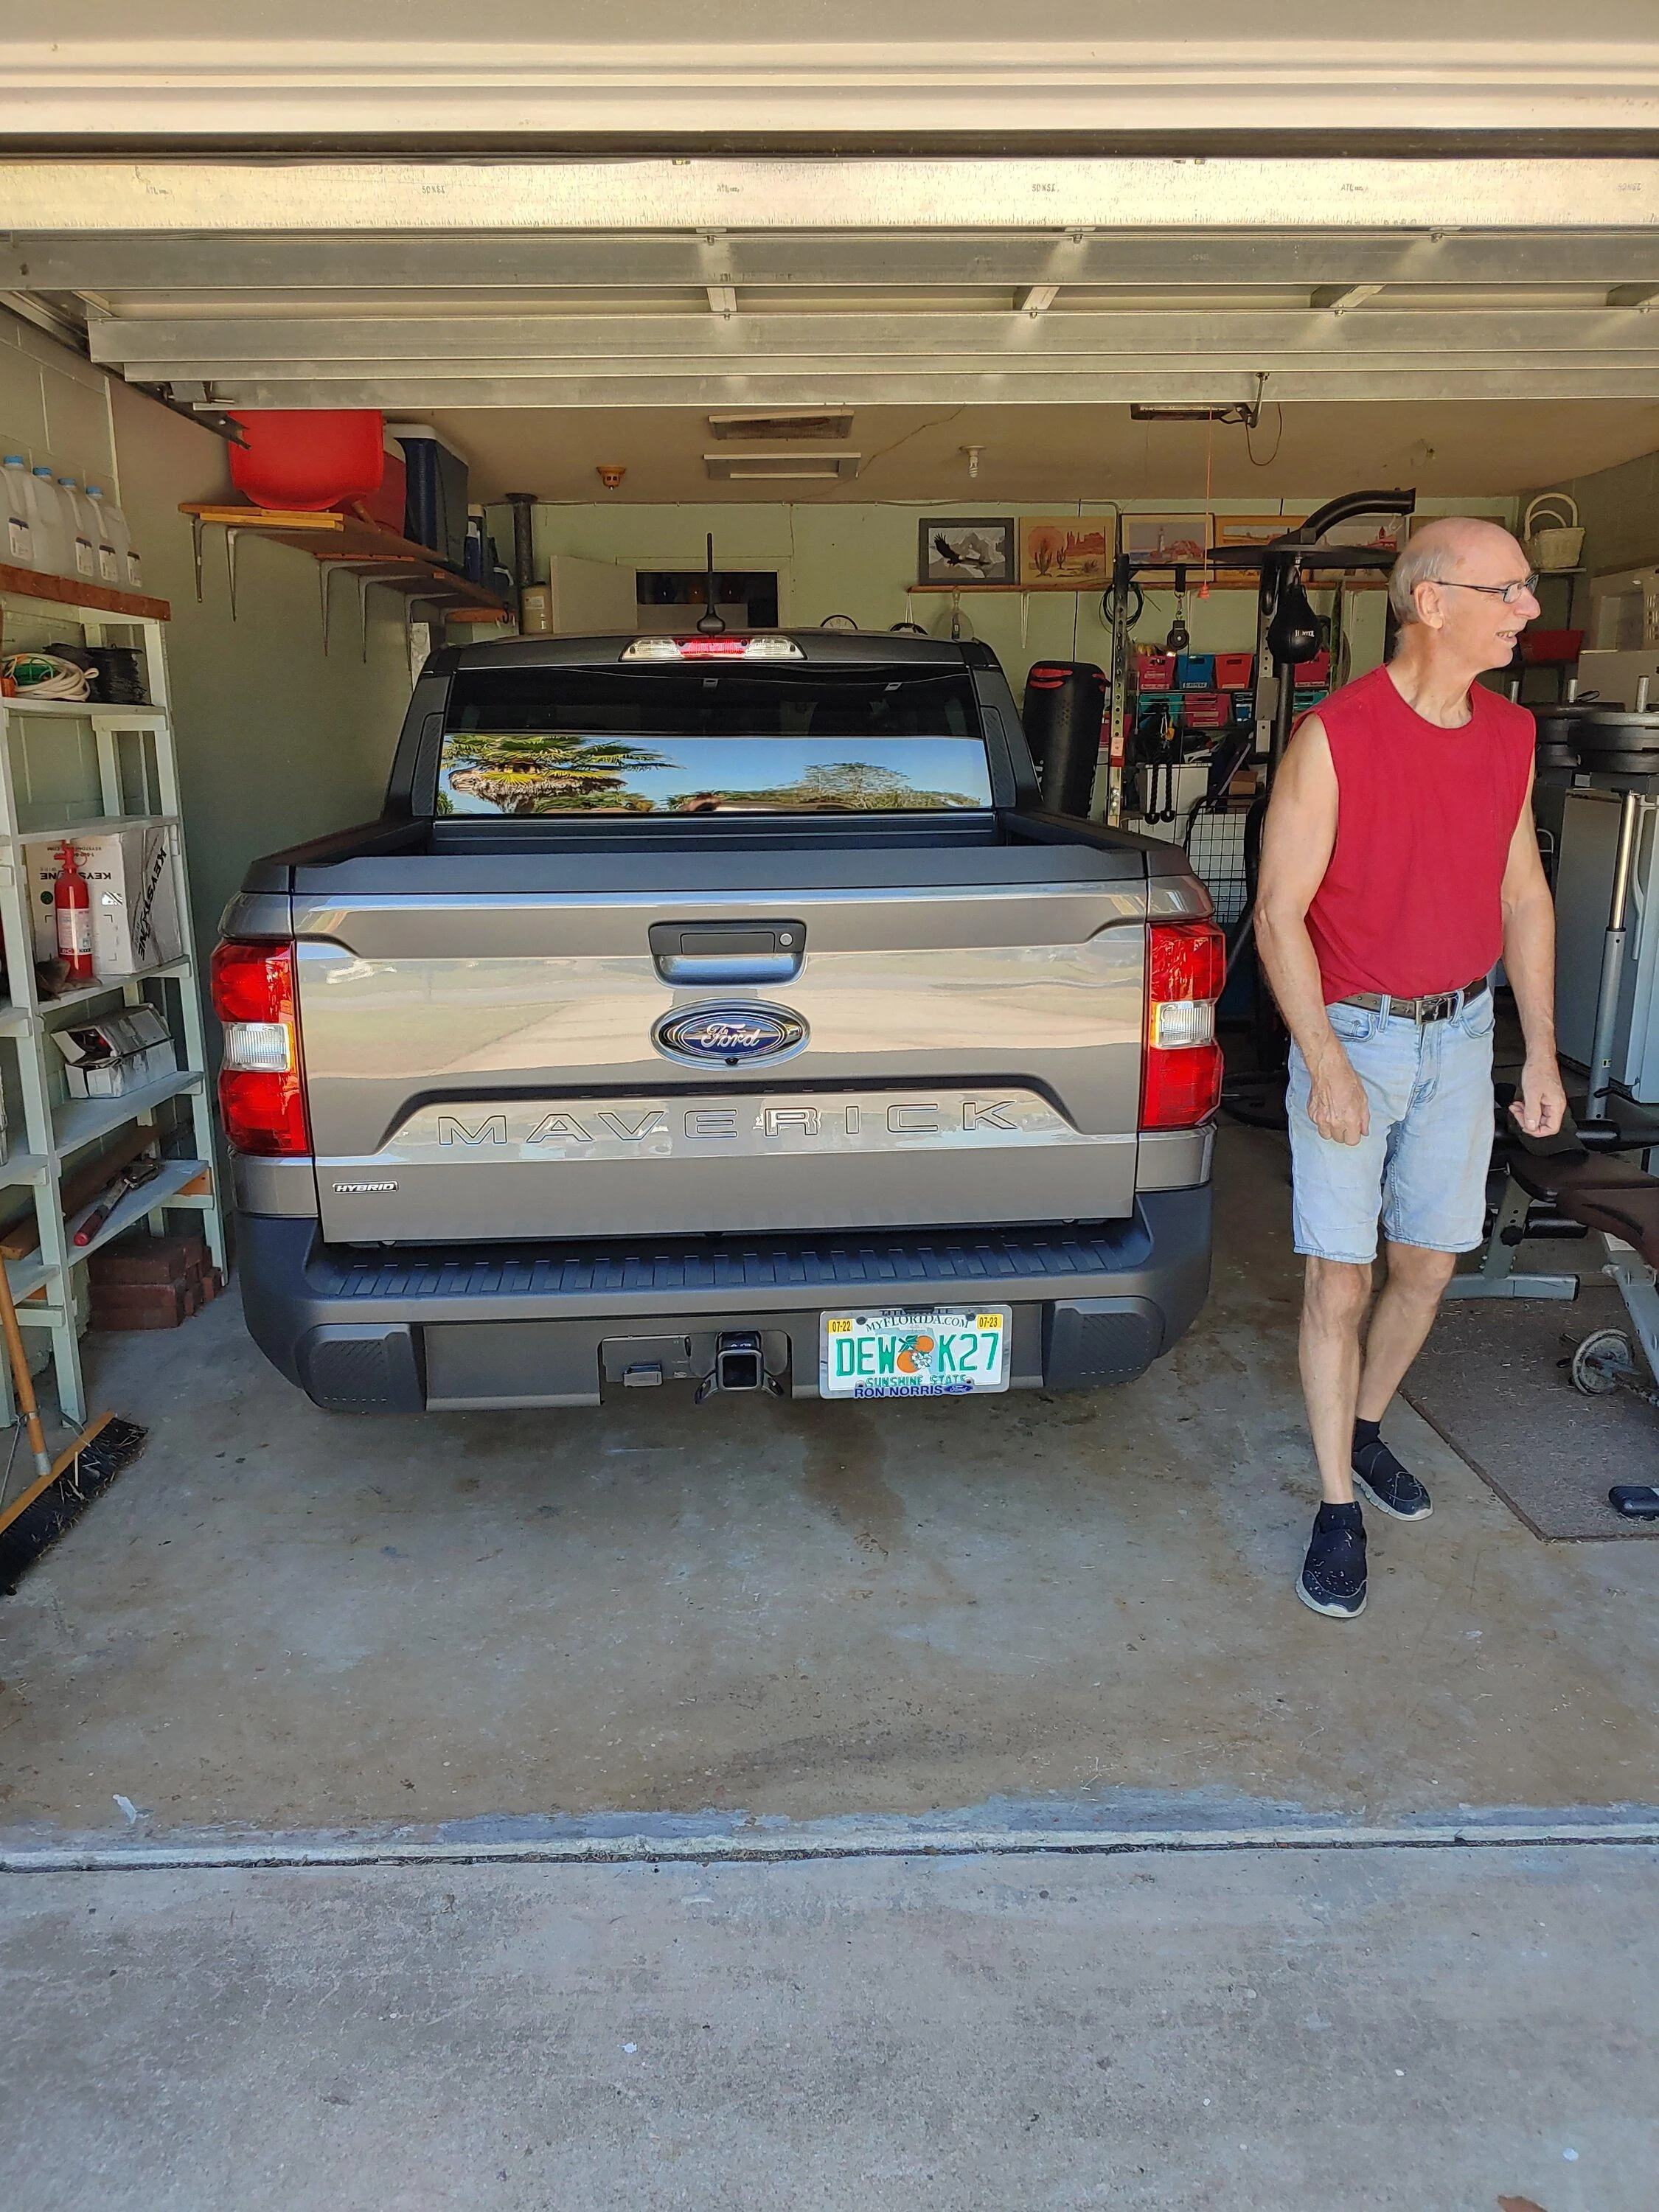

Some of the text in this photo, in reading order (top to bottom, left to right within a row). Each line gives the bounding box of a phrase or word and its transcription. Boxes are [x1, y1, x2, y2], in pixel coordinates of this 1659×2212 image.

[700, 1023, 762, 1048] Ford
[437, 1099, 1019, 1146] MAVERICK
[335, 1183, 395, 1192] HYBRID
[832, 1320, 852, 1332] 07-22
[978, 1316, 998, 1328] 07-23
[835, 1332, 998, 1377] DEW K27
[866, 1375, 924, 1387] SUNSHINE
[855, 1387, 885, 1398] RON
[889, 1385, 943, 1397] NORRIS
